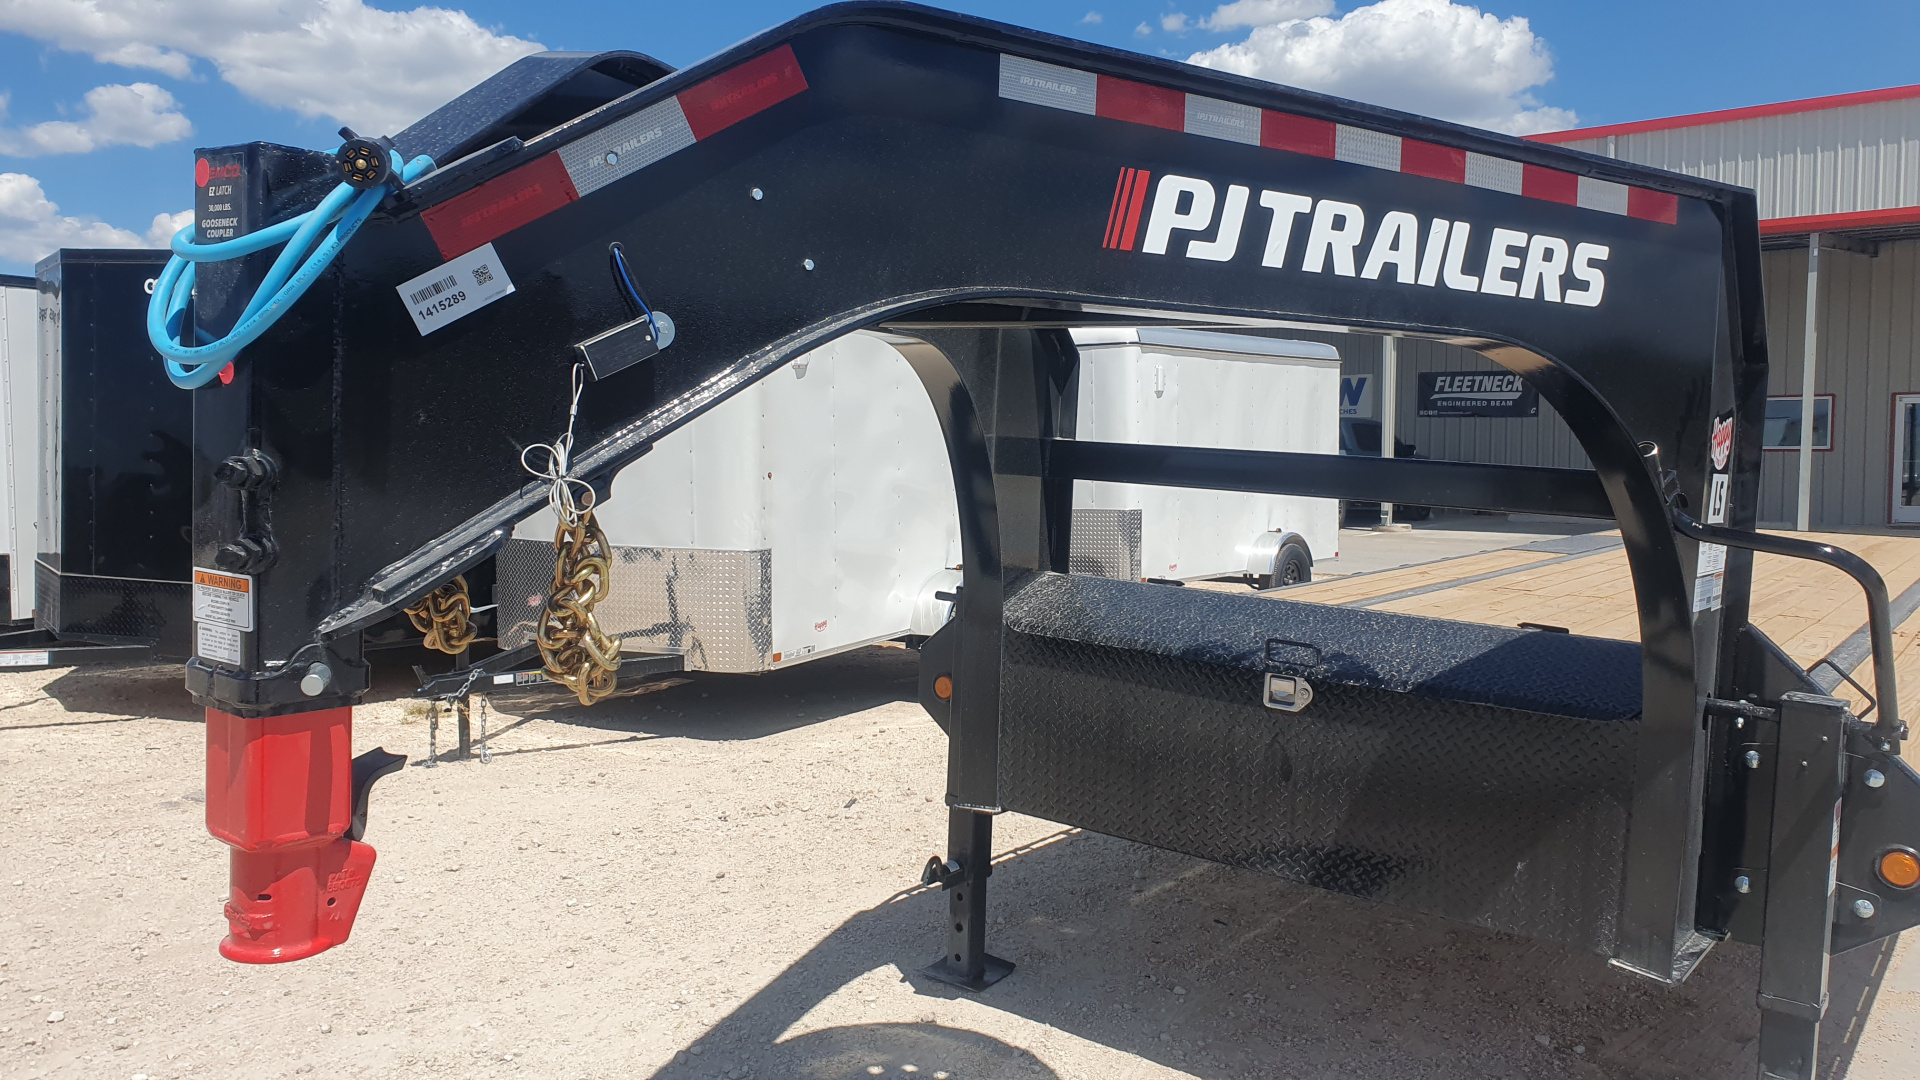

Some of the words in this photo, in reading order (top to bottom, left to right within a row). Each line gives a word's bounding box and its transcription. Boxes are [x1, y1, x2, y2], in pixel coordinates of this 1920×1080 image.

[1033, 79, 1078, 95] TRAILERS
[610, 127, 662, 156] RAILERS
[208, 186, 215, 196] EZ
[216, 185, 232, 195] LATCH
[223, 203, 232, 211] LBS.
[202, 218, 238, 228] GOOSENECK
[207, 229, 234, 238] COUPLER
[1142, 174, 1250, 262] PJ
[1259, 189, 1610, 307] TRAILERS
[418, 290, 467, 321] 1415289
[1434, 374, 1523, 392] FLEETNECK
[207, 575, 242, 590] WARNING
